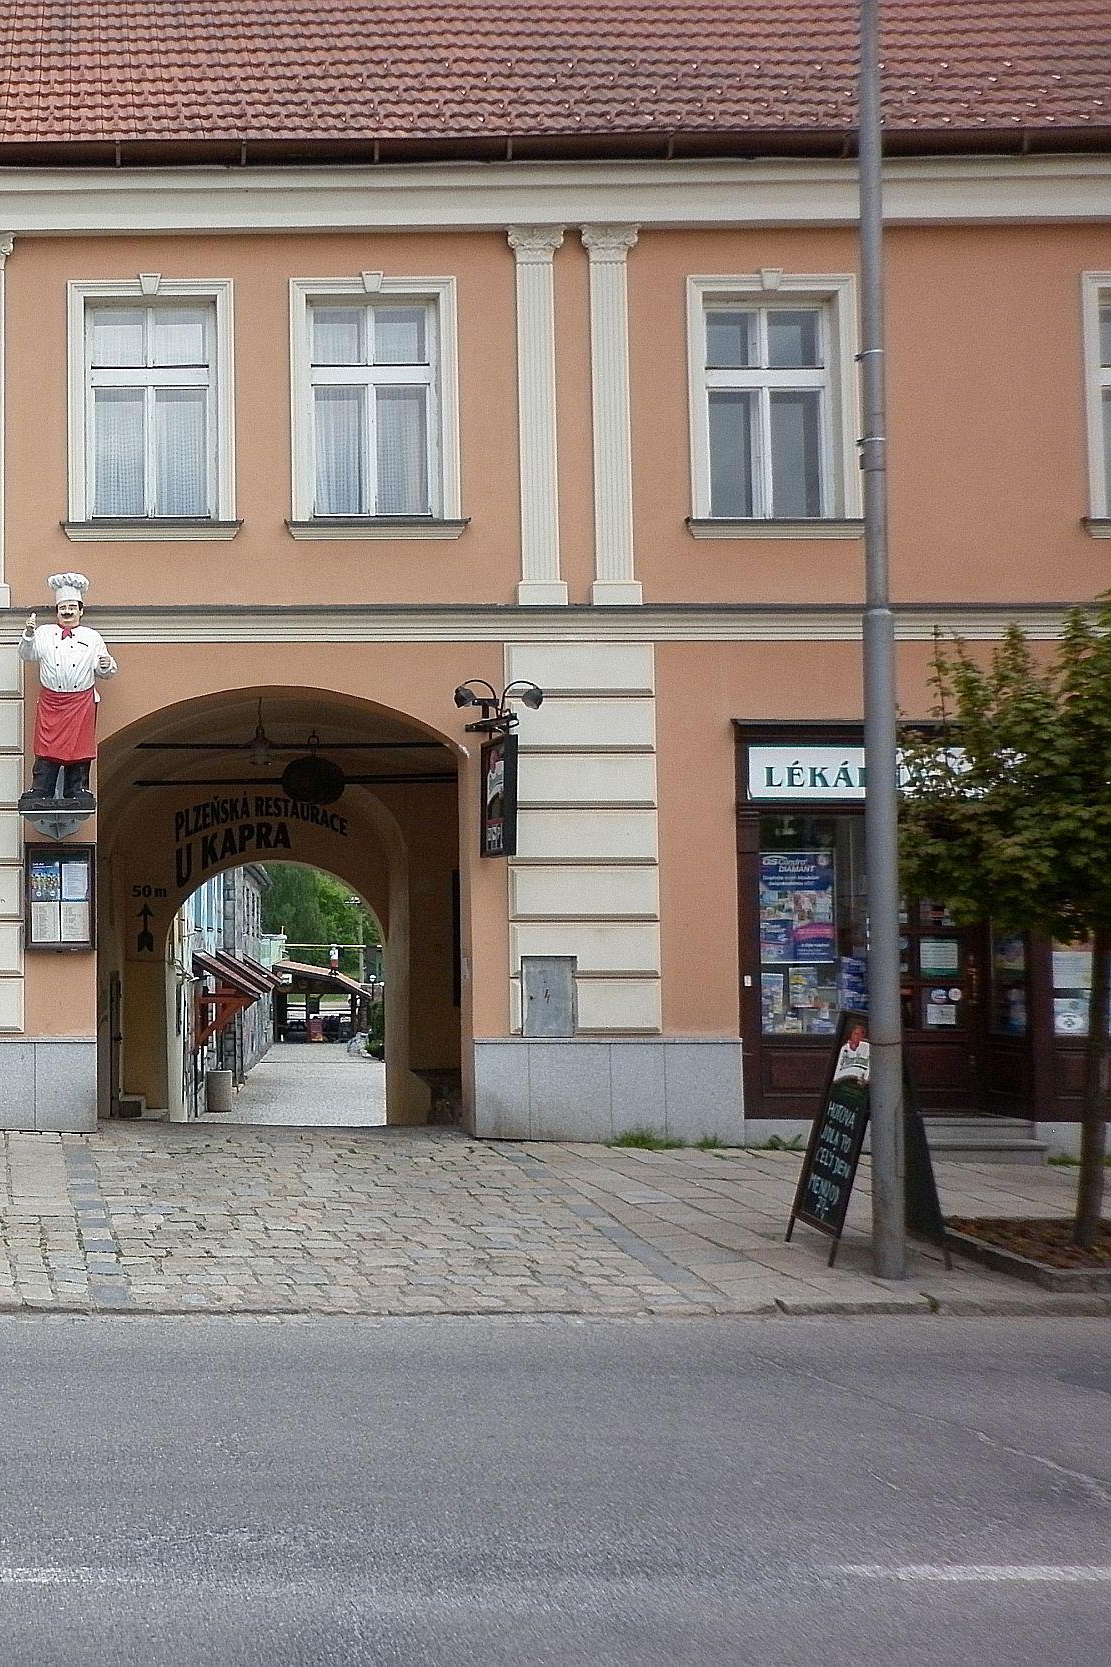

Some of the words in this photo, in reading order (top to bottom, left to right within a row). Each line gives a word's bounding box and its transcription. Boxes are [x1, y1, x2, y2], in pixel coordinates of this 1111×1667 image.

[175, 791, 250, 843] PLZEŇSKÁ
[255, 796, 348, 837] RESTAURACE
[175, 843, 193, 889] U
[201, 821, 292, 870] KAPRA
[778, 865, 816, 873] DIAMANT
[132, 885, 152, 897] 50
[154, 888, 167, 897] m
